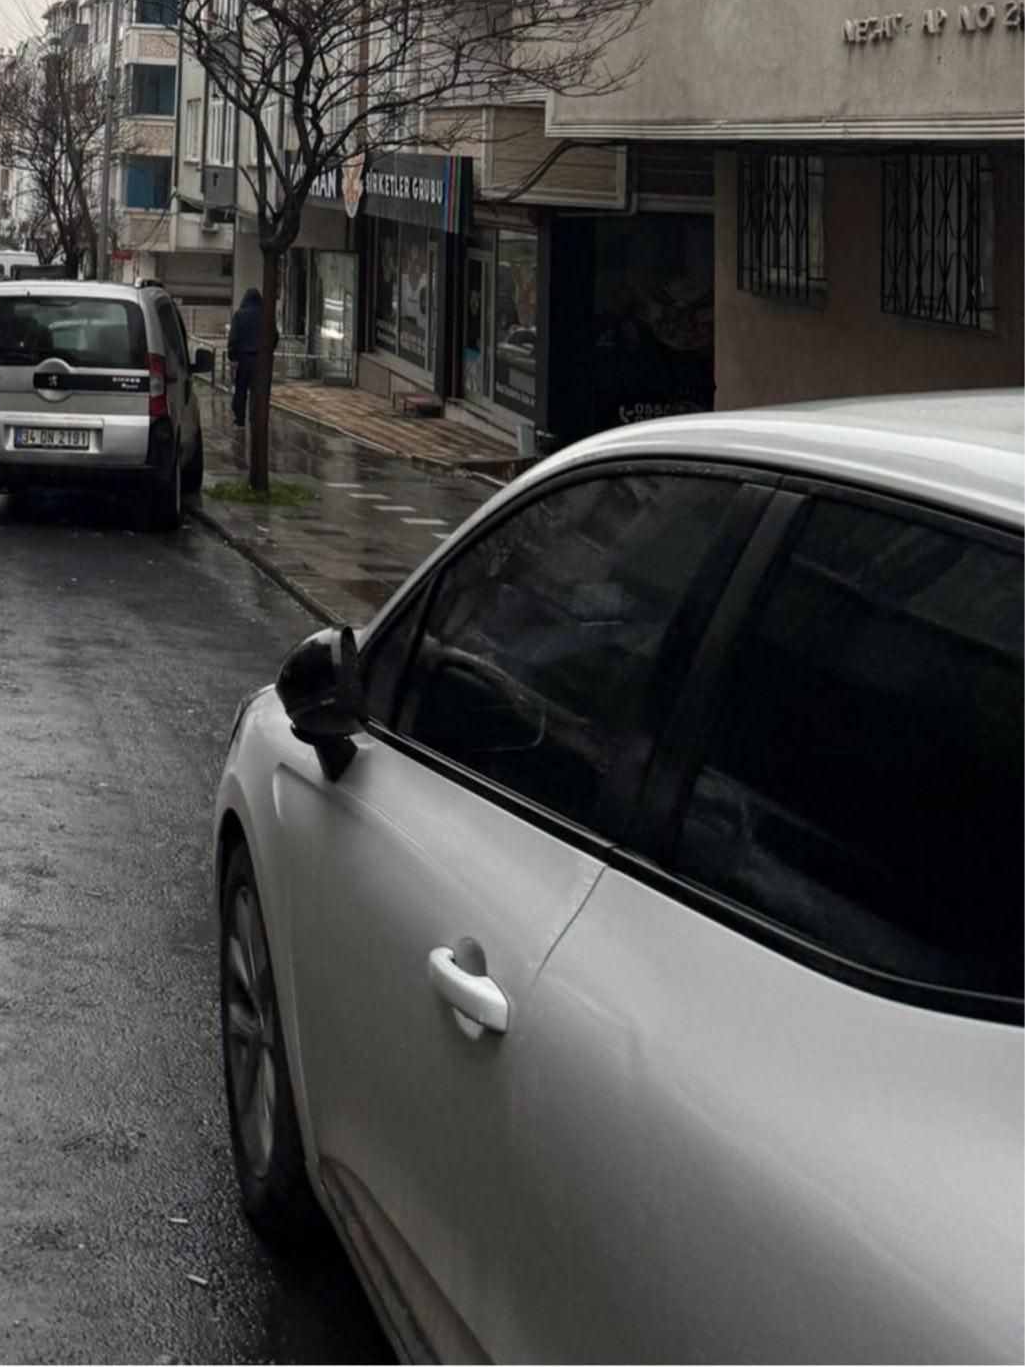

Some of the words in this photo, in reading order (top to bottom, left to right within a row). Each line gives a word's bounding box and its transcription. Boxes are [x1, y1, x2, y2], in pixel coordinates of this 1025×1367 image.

[959, 3, 996, 31] NO
[412, 176, 444, 205] GRUBU
[22, 430, 36, 444] 34
[58, 431, 86, 445] 2191
